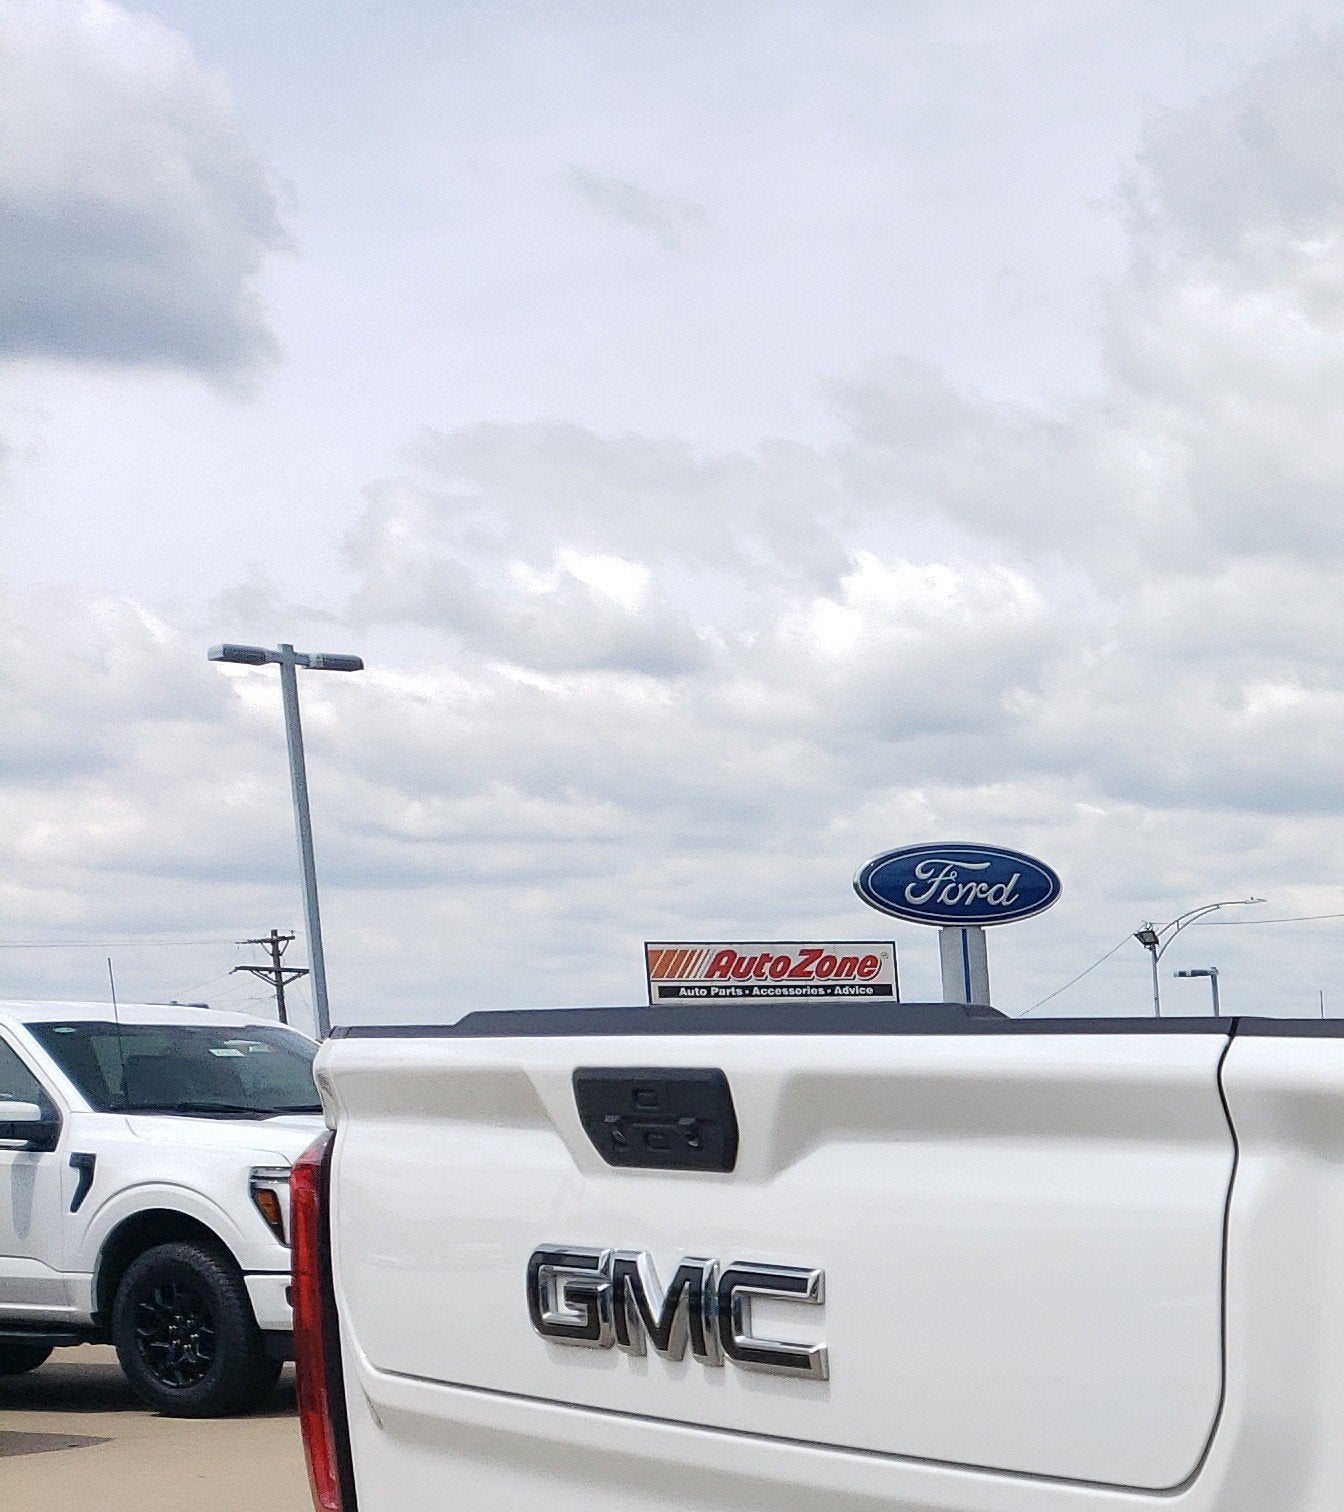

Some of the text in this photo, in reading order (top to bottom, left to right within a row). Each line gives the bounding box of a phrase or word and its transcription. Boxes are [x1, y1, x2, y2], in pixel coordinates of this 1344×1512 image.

[904, 859, 1021, 906] Ford
[703, 948, 882, 981] AutoZone
[679, 985, 874, 997] Auto Parts Accessories Advice
[526, 1243, 830, 1381] GMC
